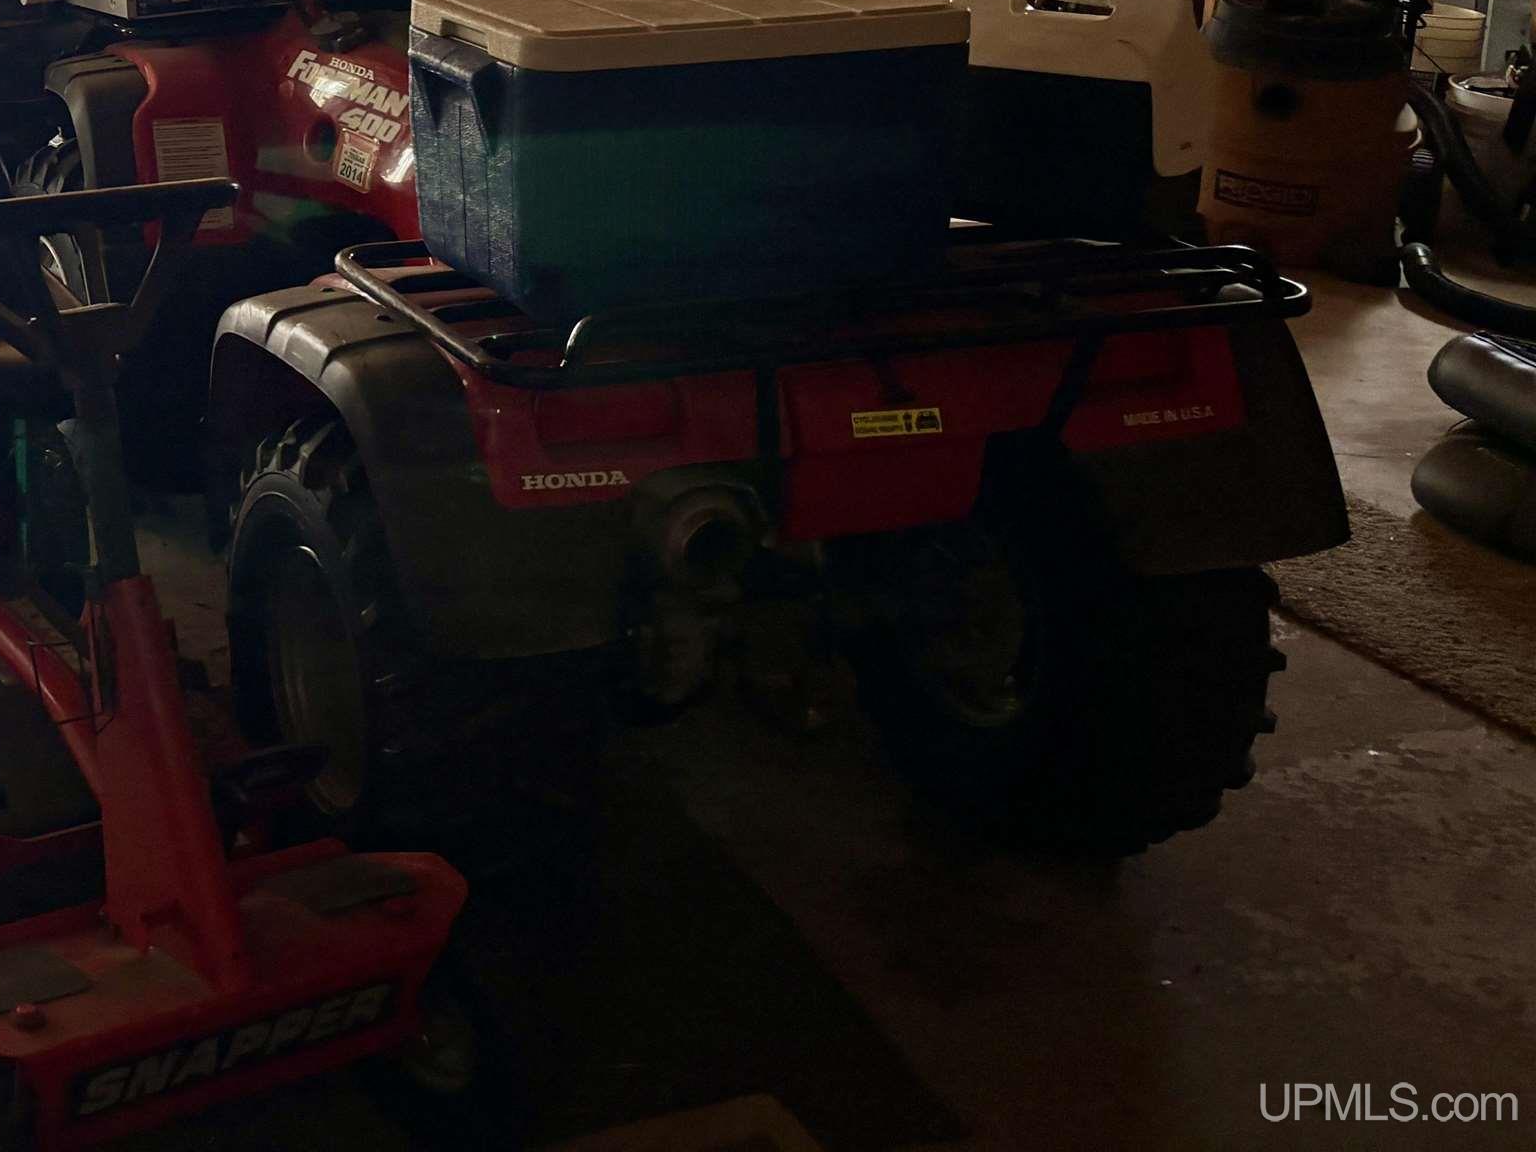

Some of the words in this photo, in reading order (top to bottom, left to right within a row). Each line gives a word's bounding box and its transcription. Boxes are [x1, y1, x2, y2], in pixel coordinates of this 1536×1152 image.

[329, 56, 375, 81] HONDA
[338, 107, 402, 143] 400
[339, 161, 363, 184] 2014
[521, 470, 631, 490] HONDA
[78, 983, 393, 1115] SNAPPER
